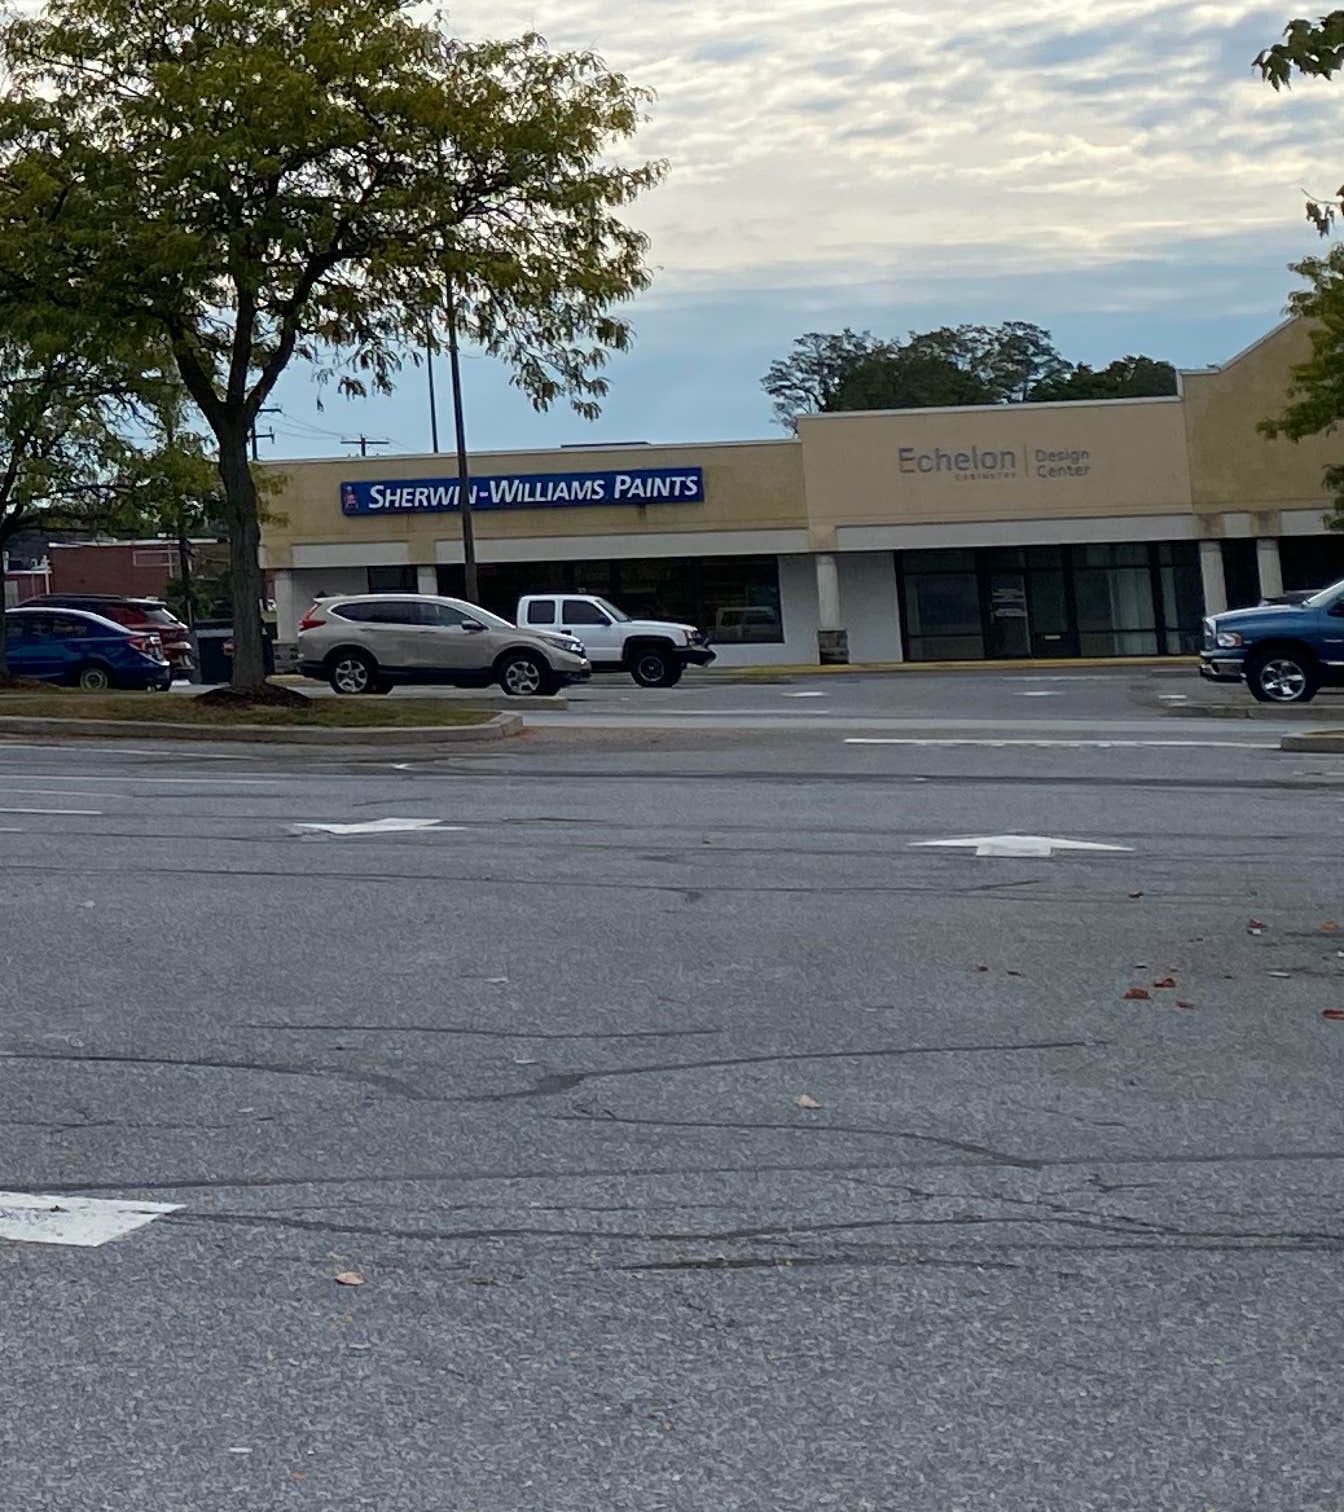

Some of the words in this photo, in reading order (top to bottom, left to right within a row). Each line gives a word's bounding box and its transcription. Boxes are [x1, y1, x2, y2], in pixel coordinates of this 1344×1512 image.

[898, 445, 1016, 473] Echelon
[1035, 449, 1090, 464] Design
[1037, 464, 1090, 478] Center
[368, 479, 606, 509] SHERWIN-WILLIAMS
[613, 475, 698, 499] PAINTS
